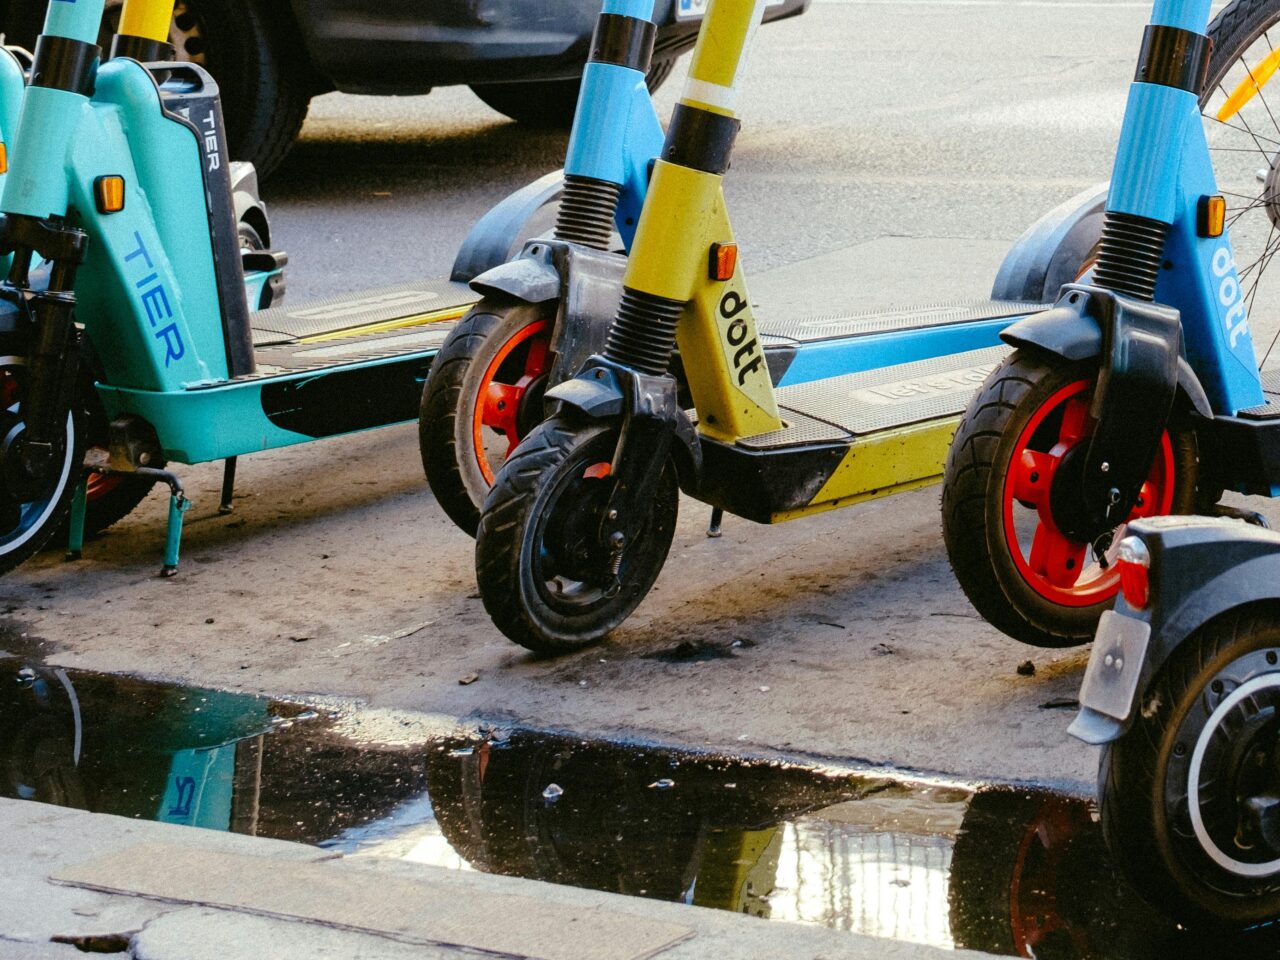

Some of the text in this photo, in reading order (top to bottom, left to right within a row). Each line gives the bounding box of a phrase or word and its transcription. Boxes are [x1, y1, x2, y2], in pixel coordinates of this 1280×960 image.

[202, 109, 221, 173] TIER
[124, 230, 185, 369] TIER
[719, 290, 761, 386] dott
[1212, 247, 1249, 349] dott
